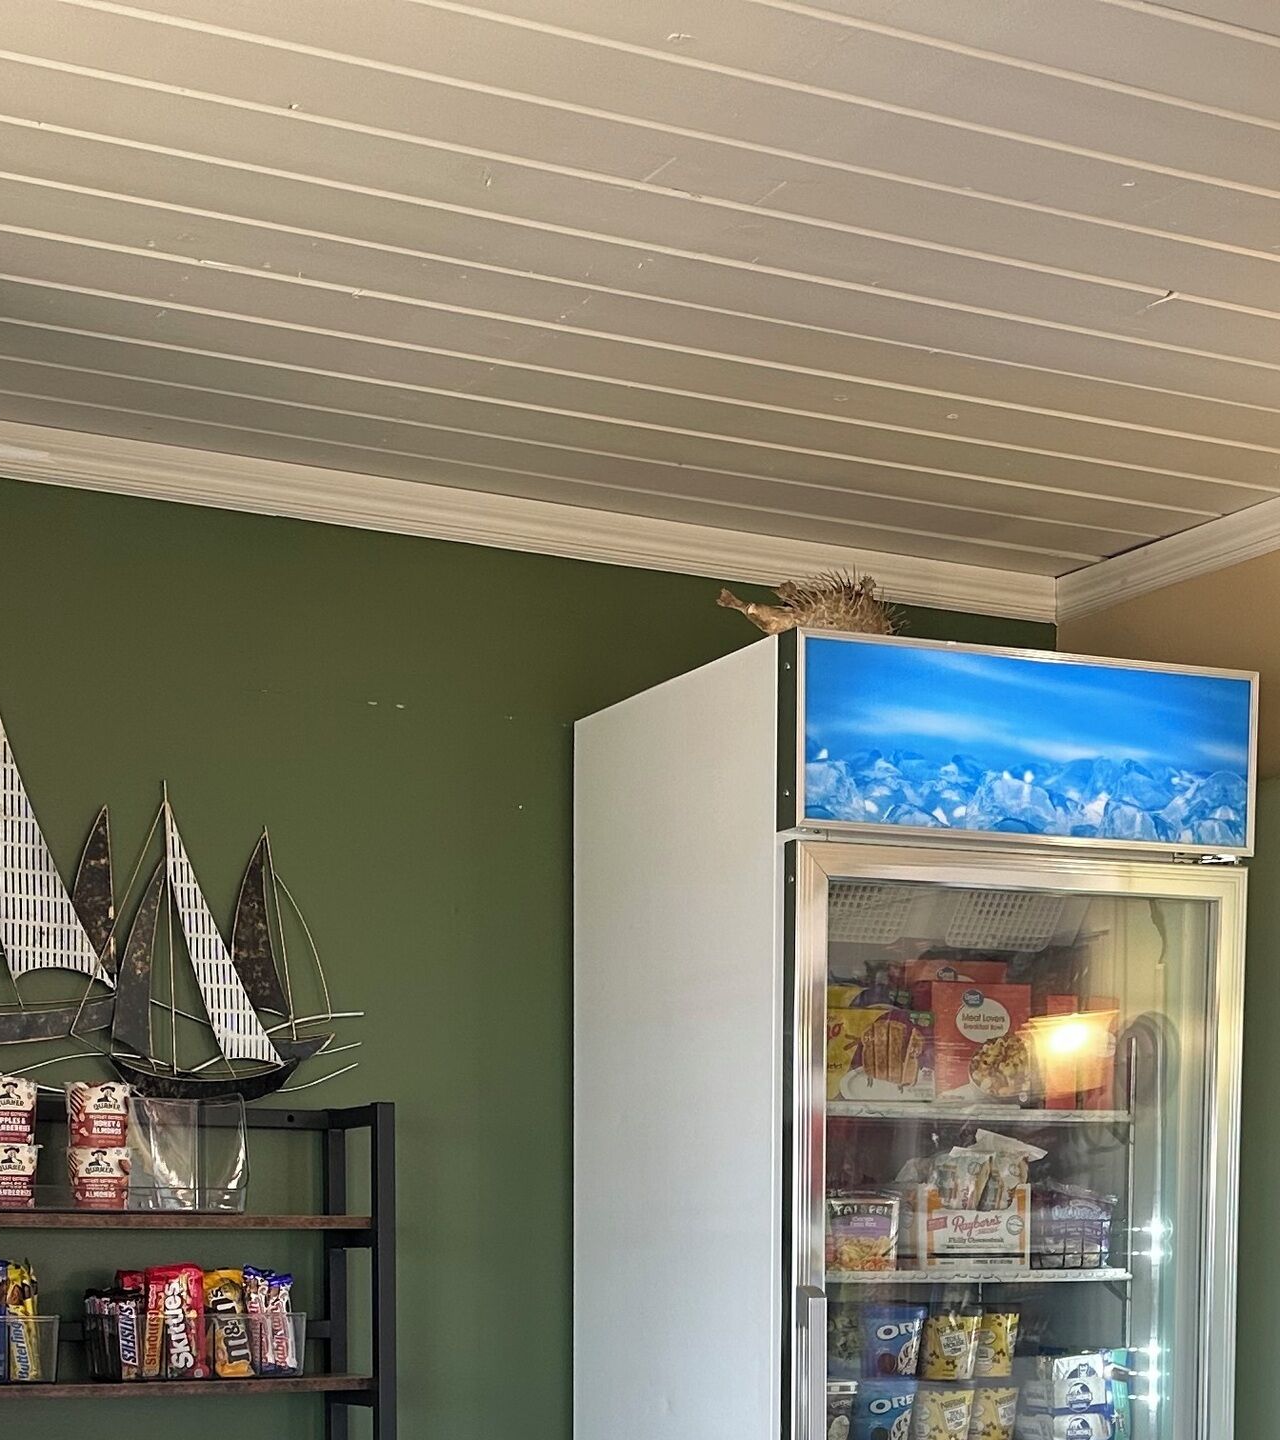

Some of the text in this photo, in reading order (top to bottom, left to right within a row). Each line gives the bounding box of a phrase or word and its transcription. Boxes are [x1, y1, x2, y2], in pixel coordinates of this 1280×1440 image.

[961, 1013, 1006, 1023] Meat Lovers
[119, 1302, 137, 1364] SNICKERS
[164, 1281, 194, 1368] Skittles
[869, 1393, 915, 1414] ORE
